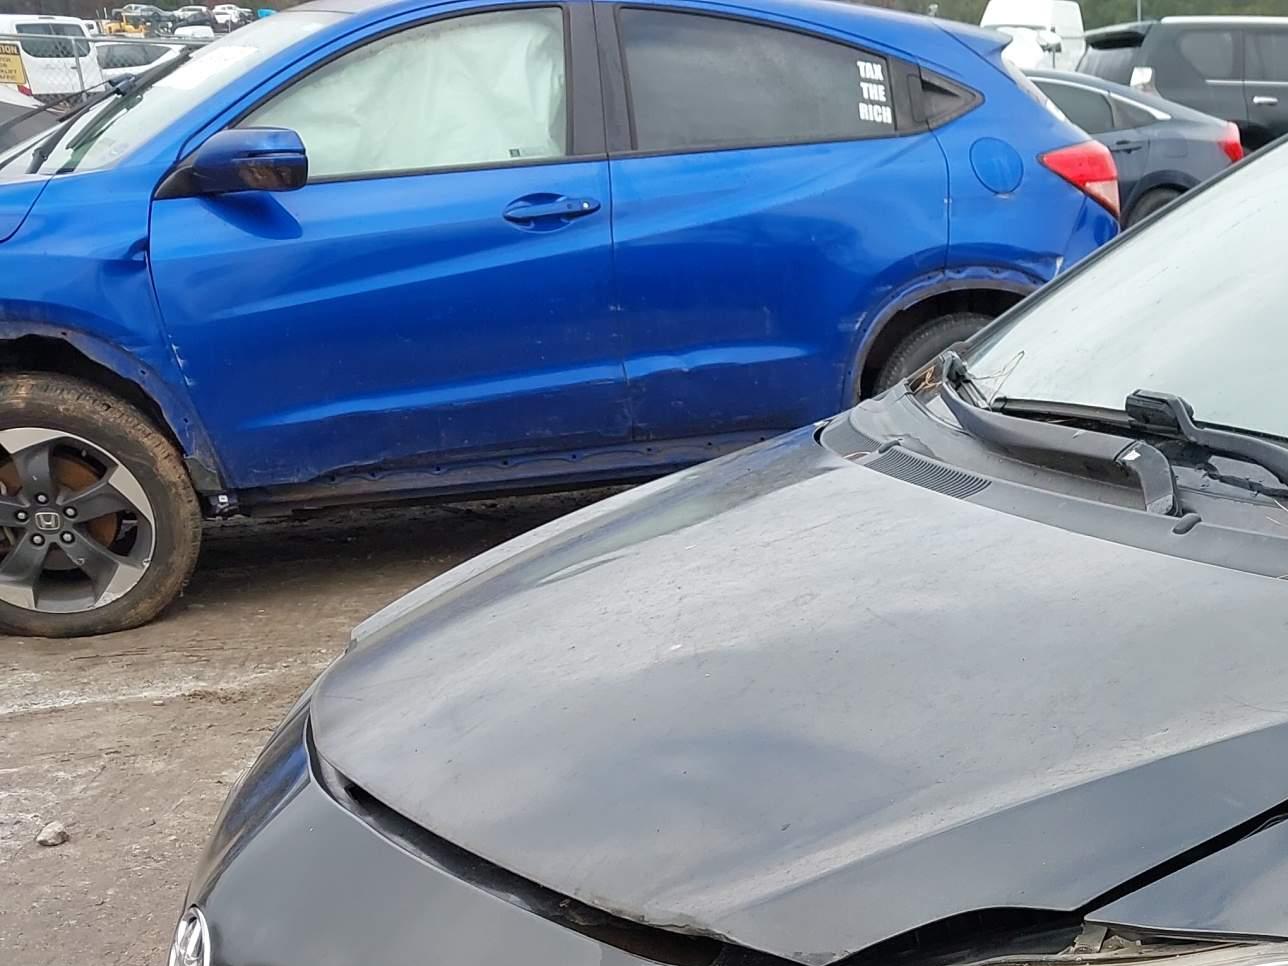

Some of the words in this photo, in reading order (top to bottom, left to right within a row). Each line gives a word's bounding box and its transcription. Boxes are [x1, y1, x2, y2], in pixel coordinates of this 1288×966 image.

[857, 61, 884, 80] TAX
[860, 81, 887, 102] THE
[859, 102, 892, 124] RICH
